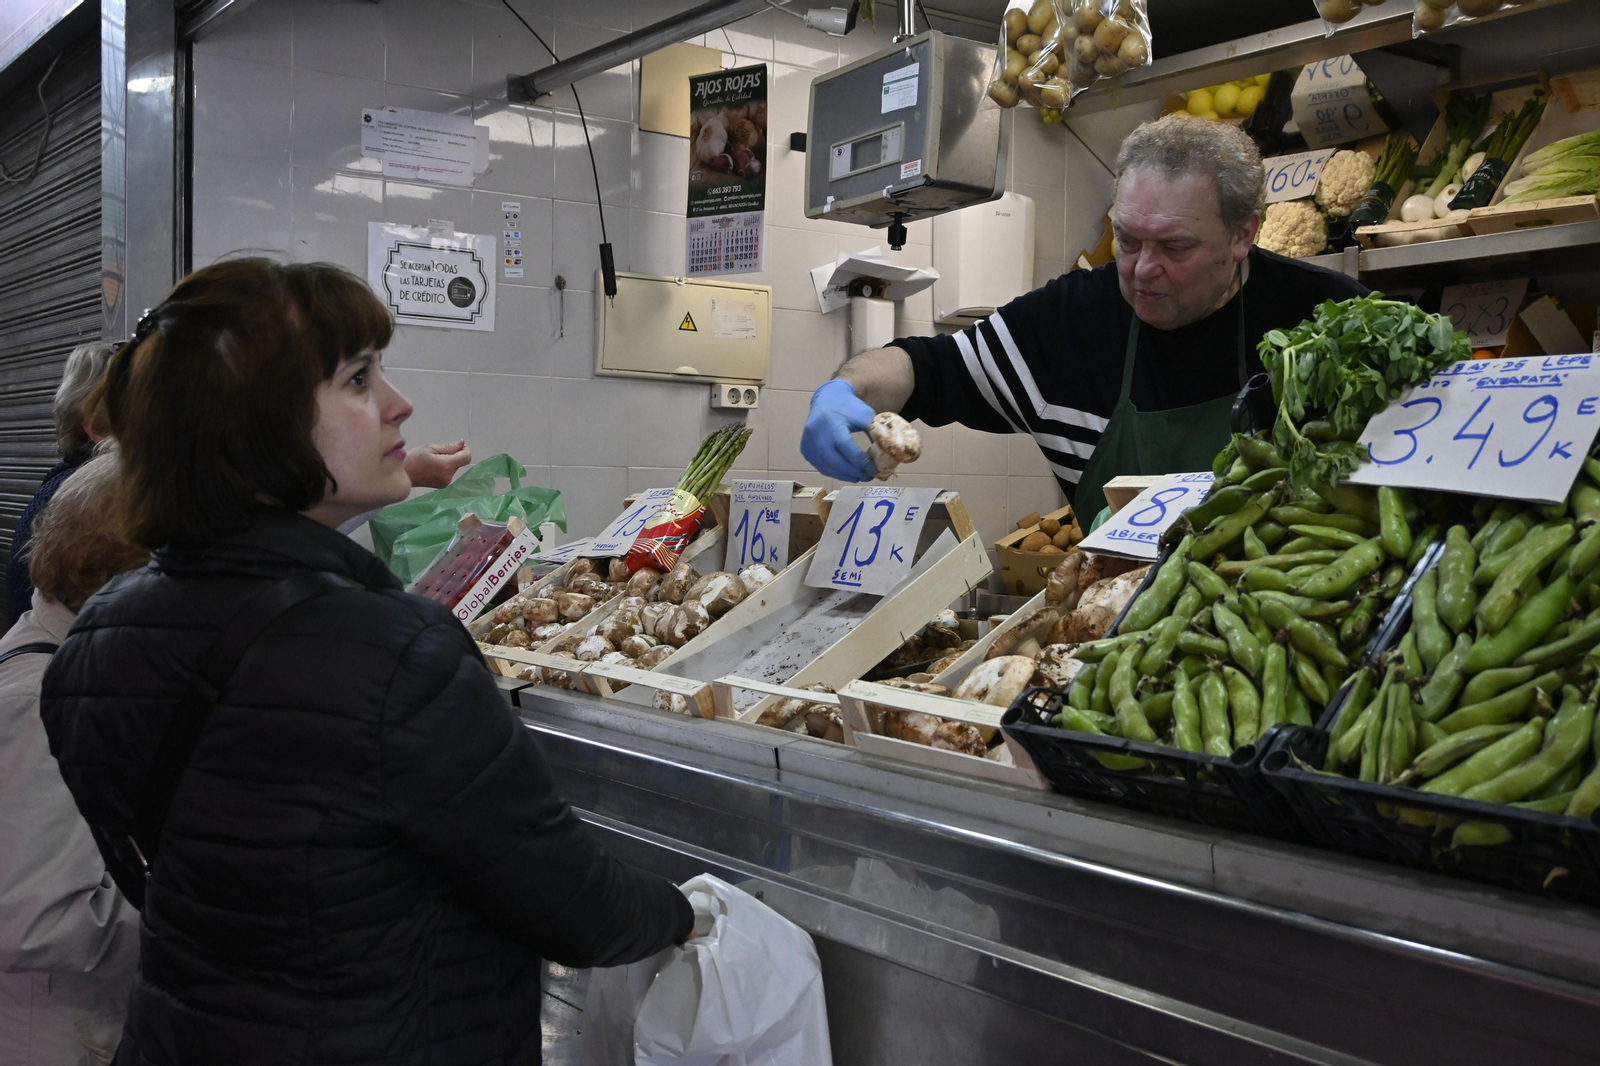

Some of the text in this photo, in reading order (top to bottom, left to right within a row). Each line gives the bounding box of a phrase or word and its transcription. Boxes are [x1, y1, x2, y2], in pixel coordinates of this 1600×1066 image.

[694, 72, 761, 99] AJOS ROJAS
[408, 261, 431, 272] ACEPTAN
[430, 260, 458, 274] TODAS
[400, 275, 445, 288] LAS TARJETAS
[400, 290, 446, 304] DE CRÉDITO
[1487, 297, 1509, 335] 3
[1443, 362, 1490, 373] BAS
[1502, 360, 1529, 369] DE
[1420, 380, 1450, 388] ara
[1367, 394, 1600, 470] 3.49 E K
[1128, 487, 1189, 526] 8
[734, 509, 765, 565] 16
[770, 546, 778, 562] K
[836, 500, 919, 568] 13 E K
[1105, 529, 1158, 540] ABIER
[457, 543, 528, 622] GlobalBerries
